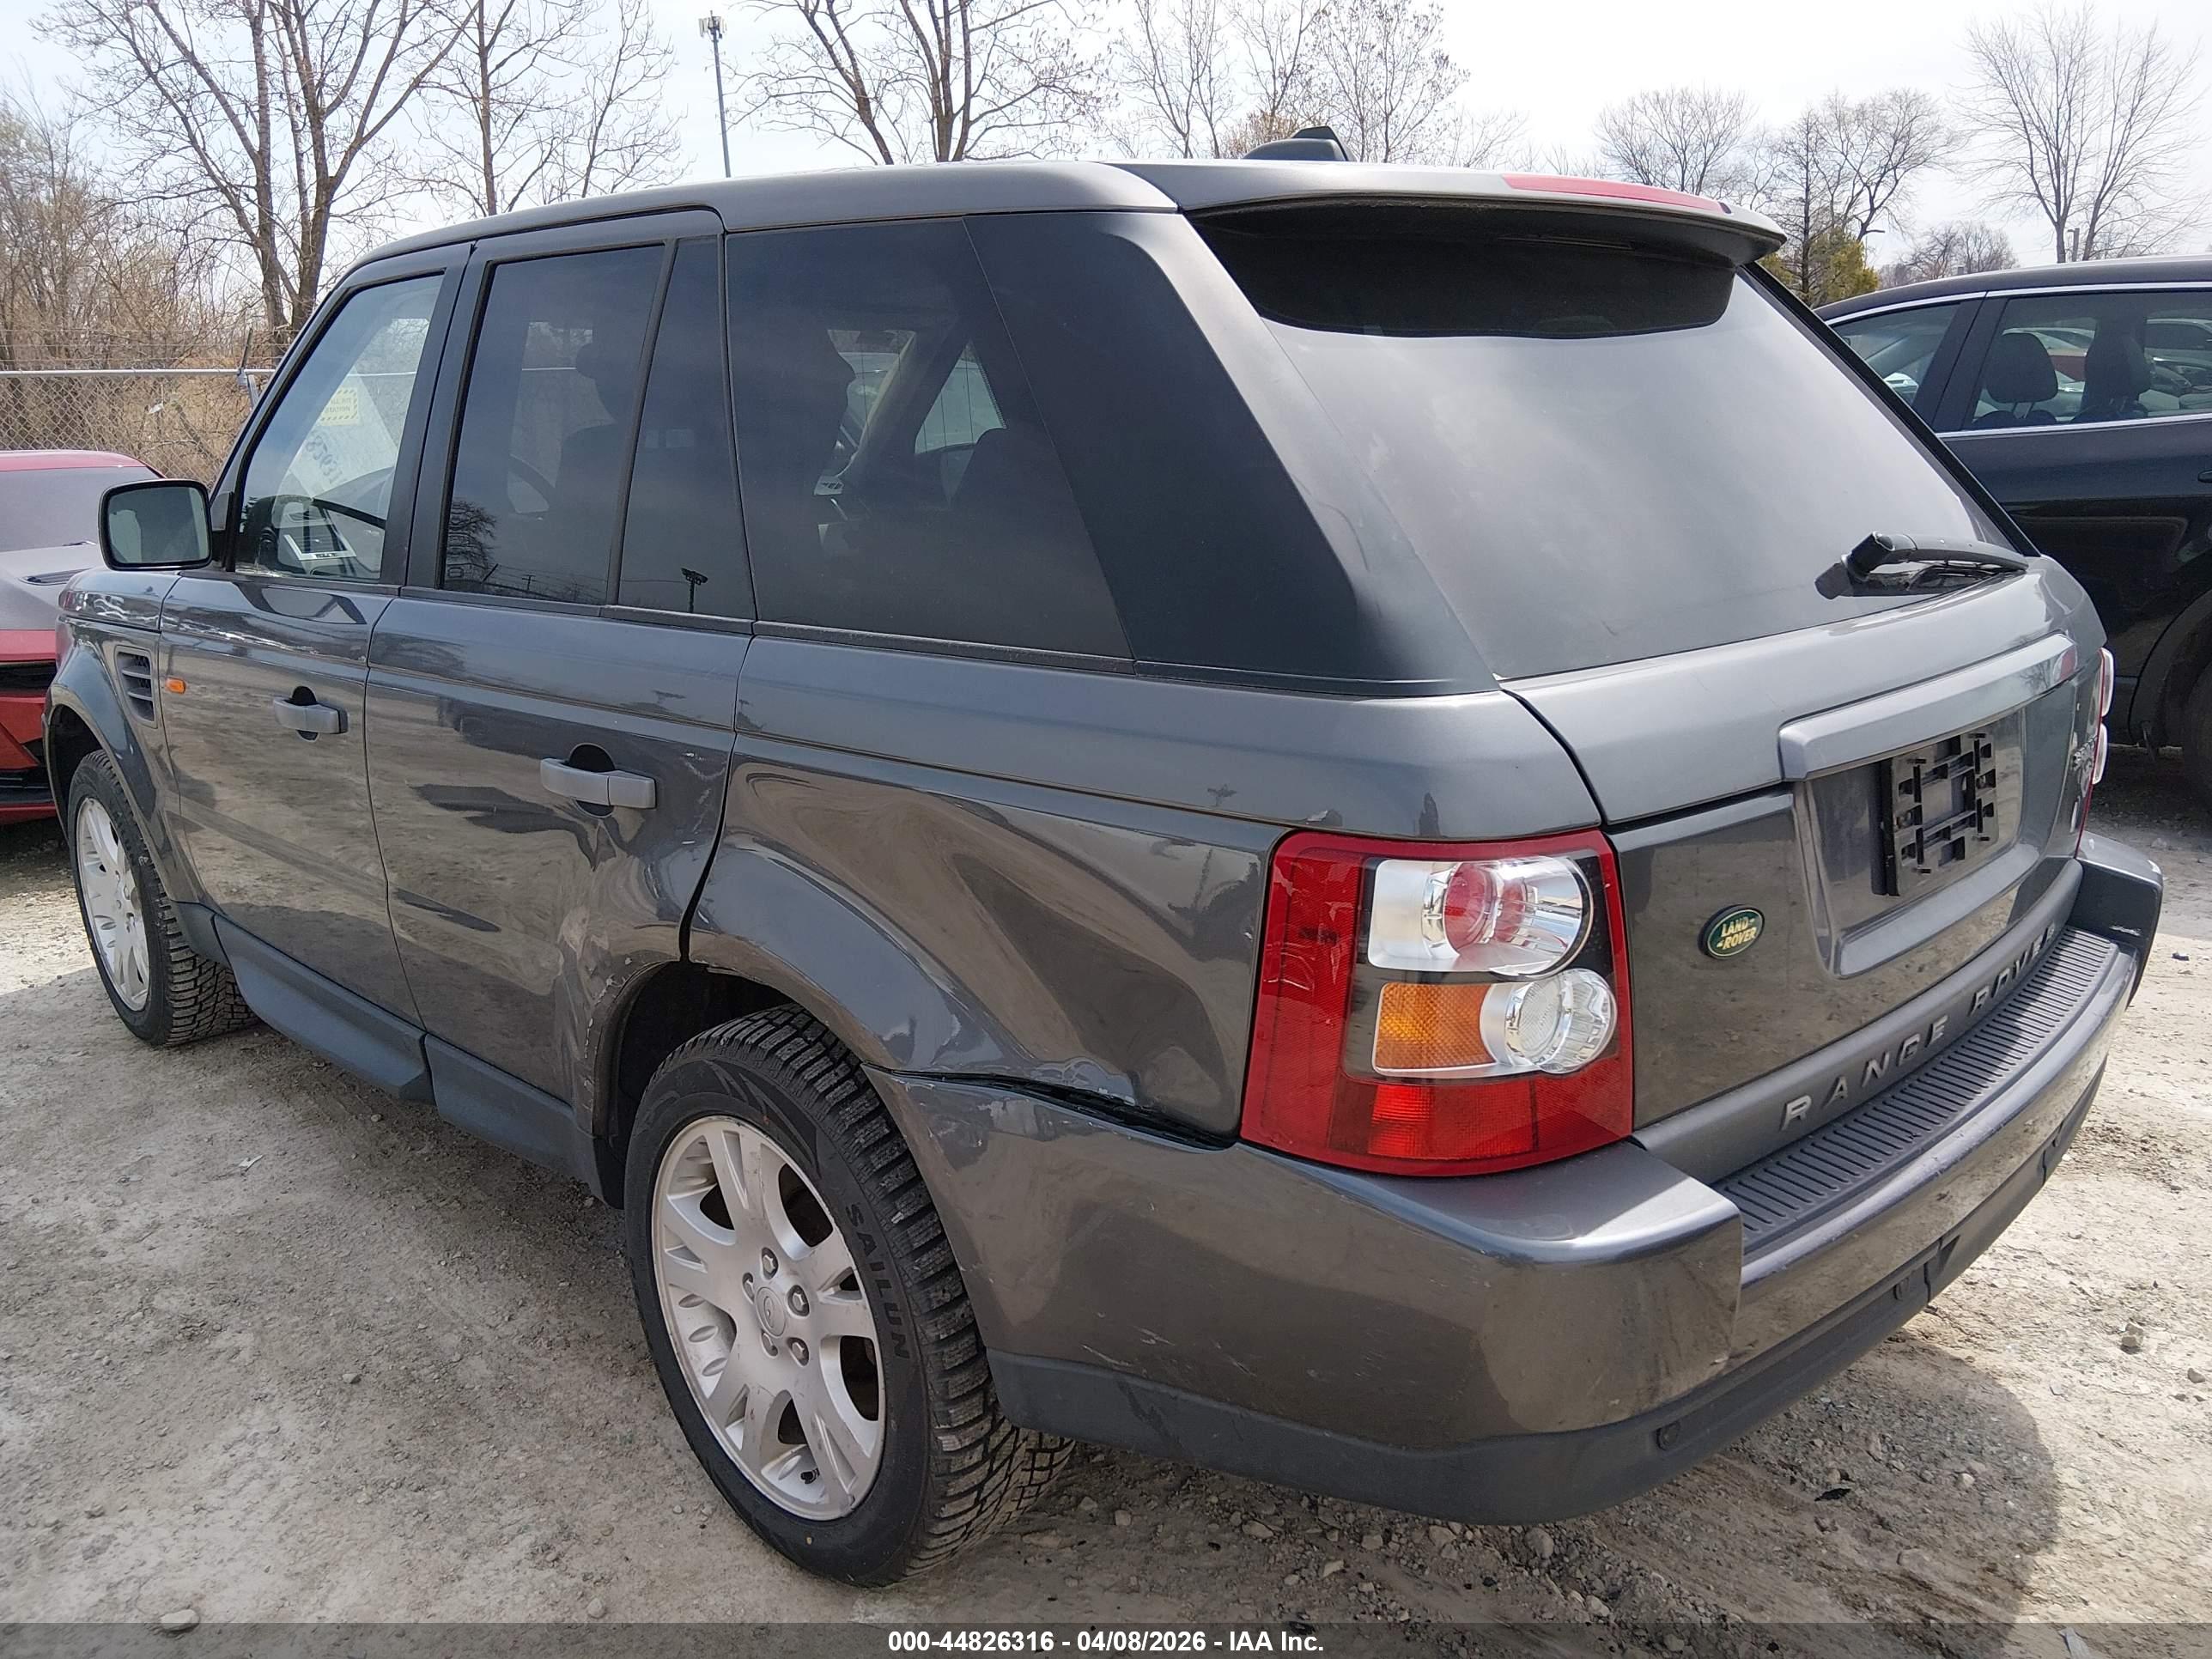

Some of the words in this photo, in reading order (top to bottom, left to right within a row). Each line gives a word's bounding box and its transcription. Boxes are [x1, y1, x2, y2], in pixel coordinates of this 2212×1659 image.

[1721, 916, 1748, 938] LAND
[1722, 927, 1757, 950] ROVER
[1781, 1016, 1948, 1131] RANGE
[846, 1204, 910, 1358] SAILUN
